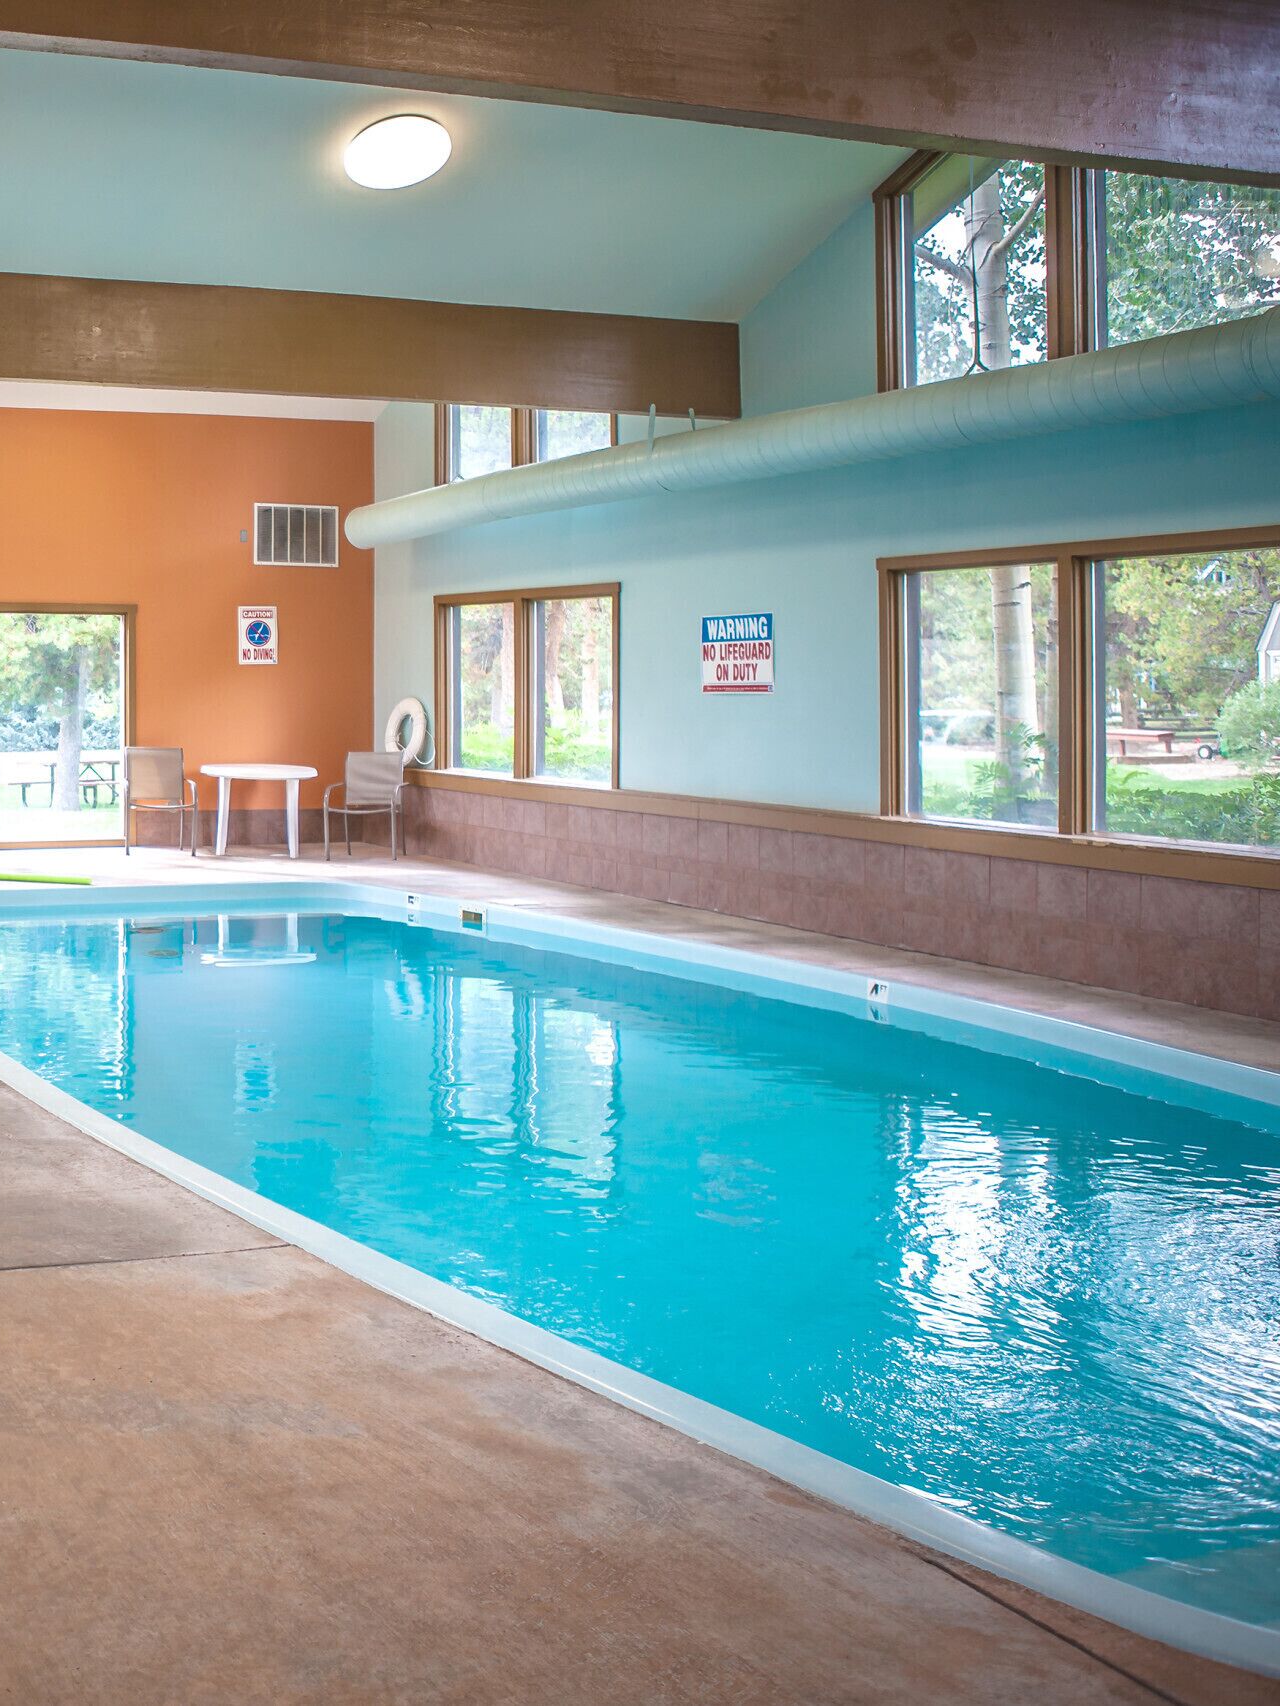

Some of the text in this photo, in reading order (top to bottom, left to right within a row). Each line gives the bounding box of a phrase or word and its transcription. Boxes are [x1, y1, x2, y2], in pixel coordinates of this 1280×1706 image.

[707, 616, 768, 640] WARNING
[242, 648, 251, 660] NO
[703, 642, 771, 662] NO LIFEGUARD
[716, 663, 758, 682] ON DUTY
